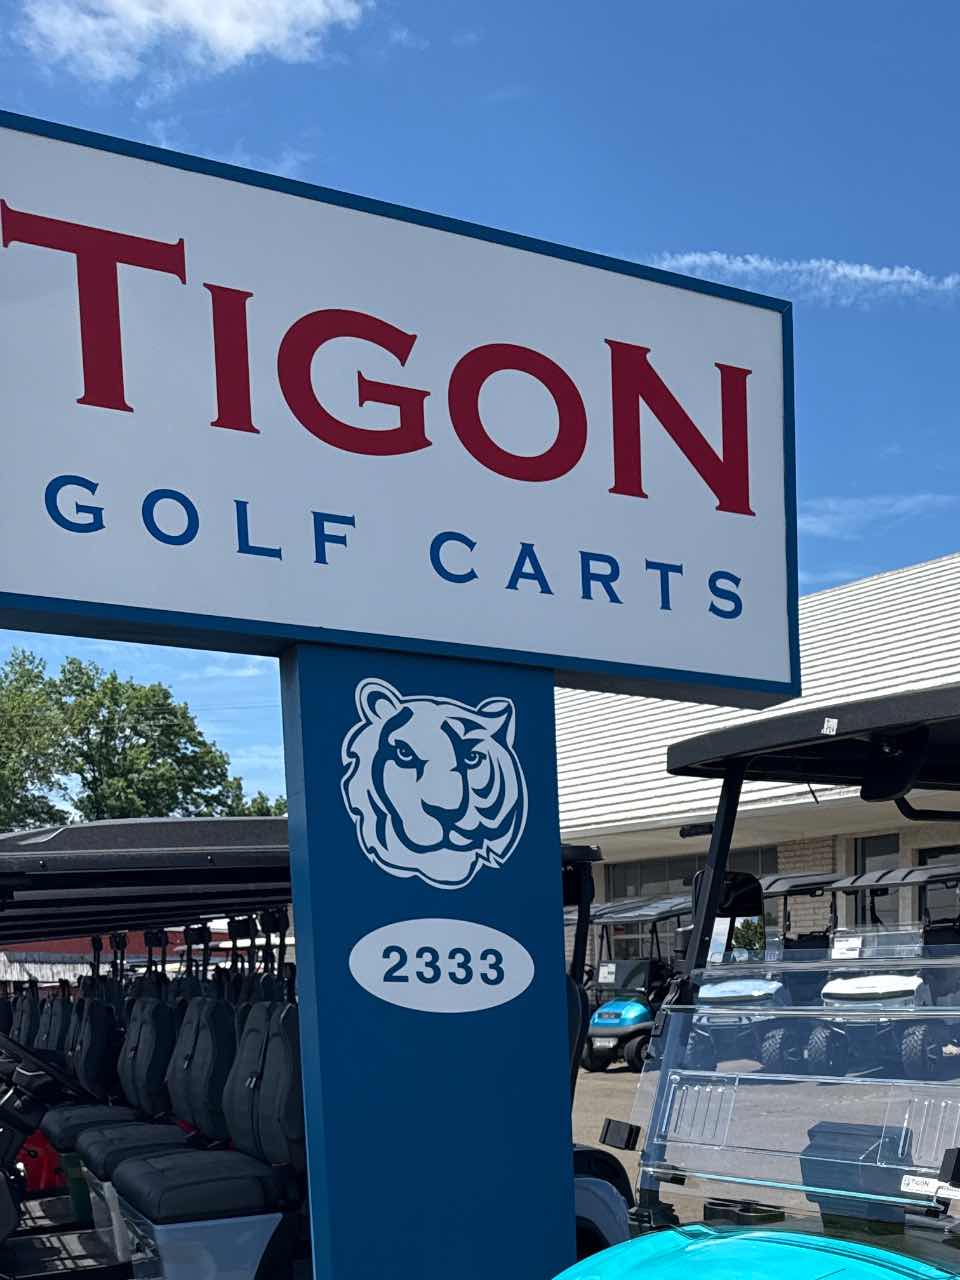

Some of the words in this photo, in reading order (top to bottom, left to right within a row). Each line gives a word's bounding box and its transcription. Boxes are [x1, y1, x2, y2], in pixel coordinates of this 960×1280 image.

[0, 199, 755, 516] TIGON
[44, 474, 356, 565] GOLF
[429, 530, 744, 620] CARTS
[381, 944, 505, 986] 2333
